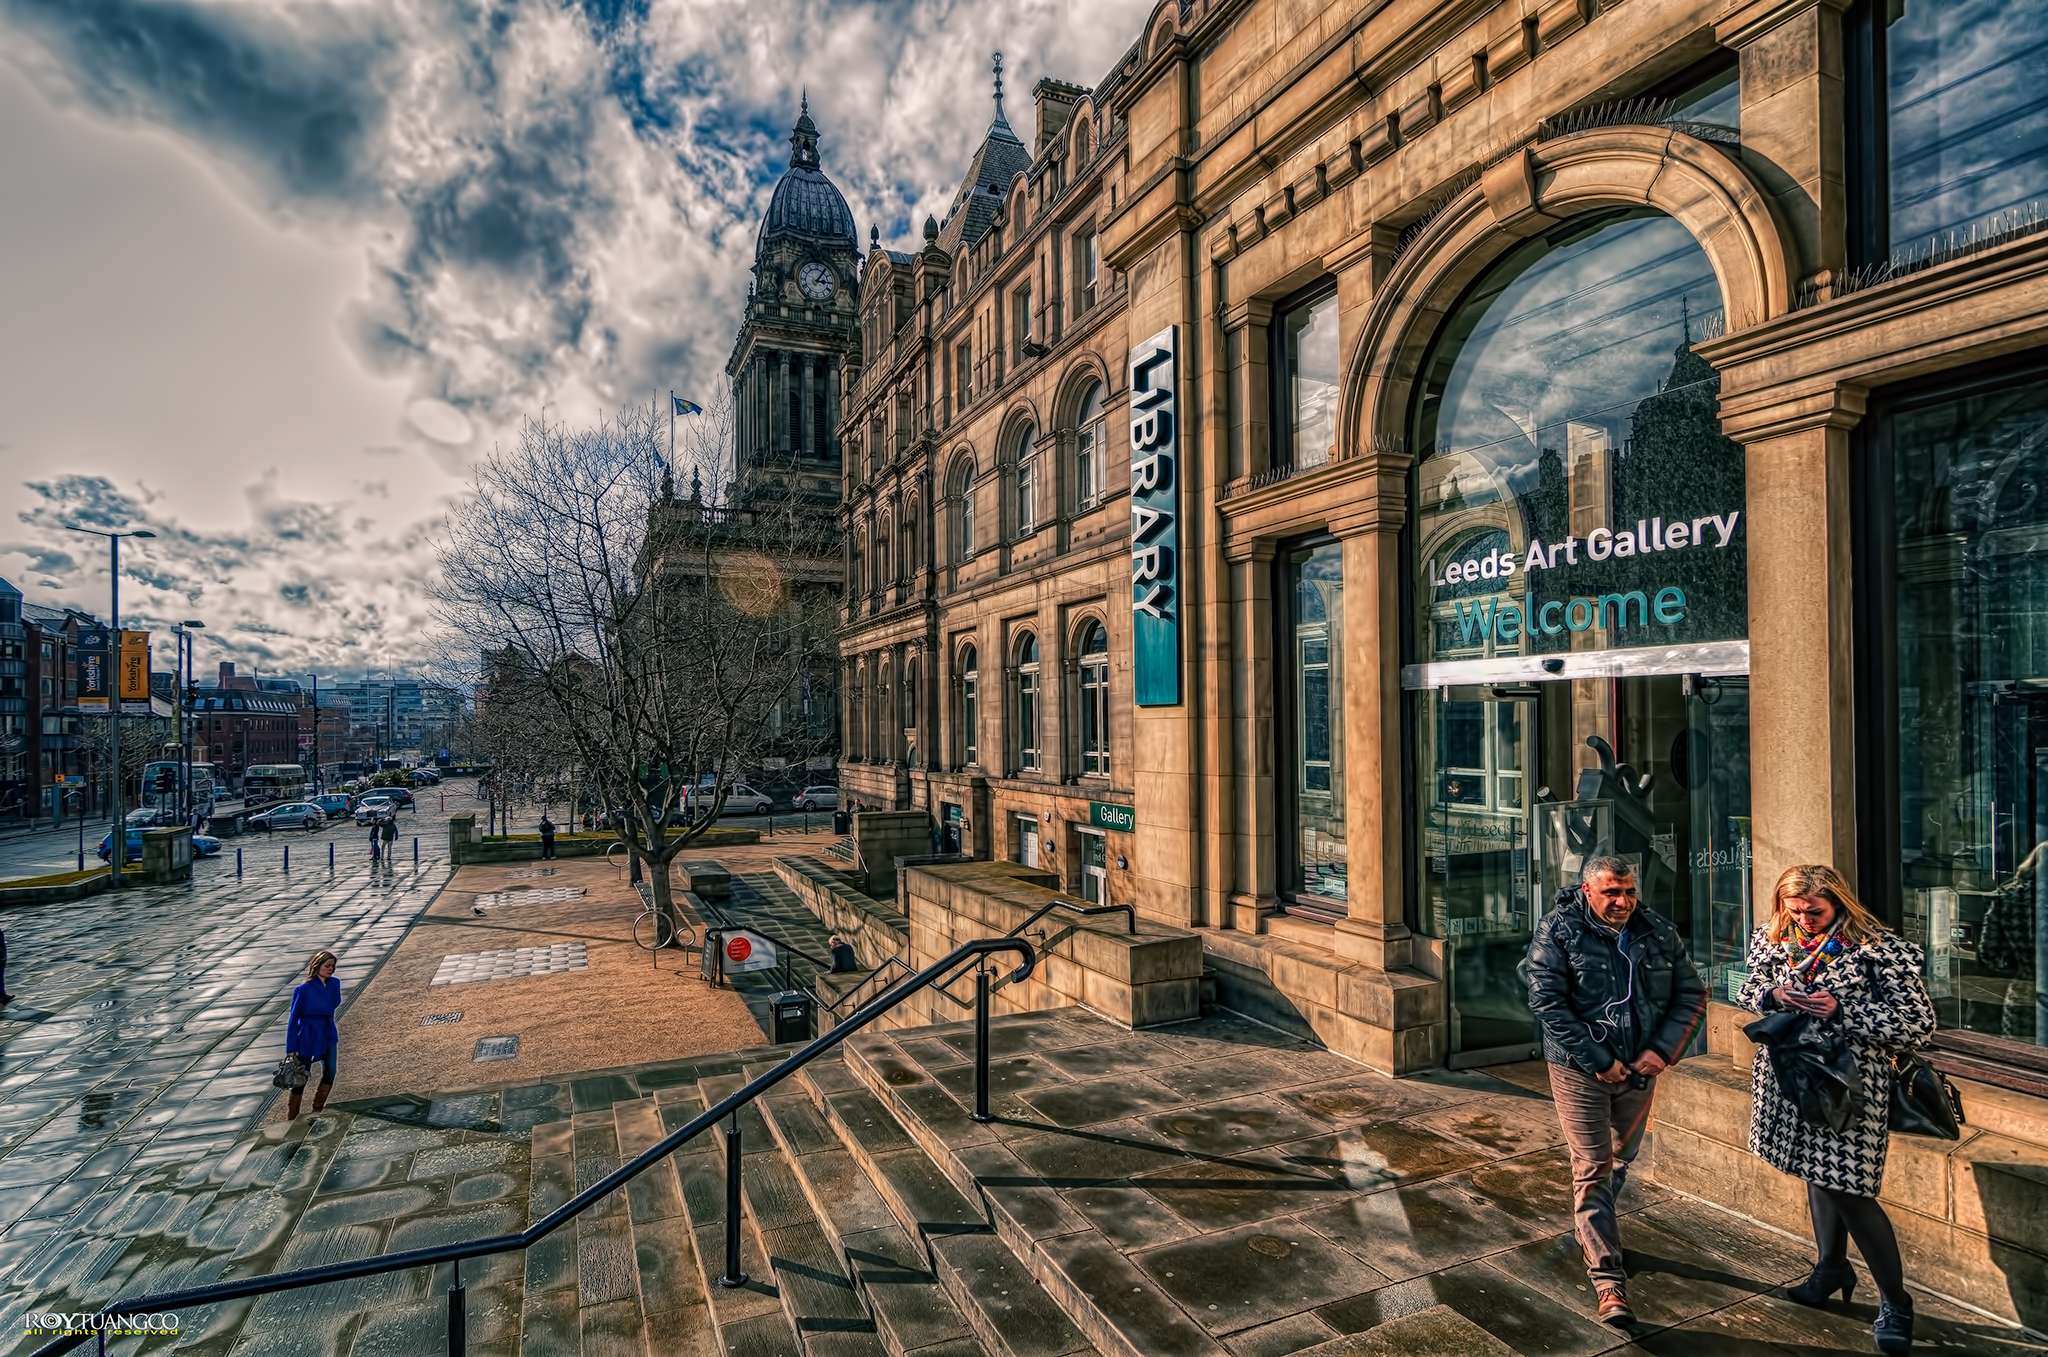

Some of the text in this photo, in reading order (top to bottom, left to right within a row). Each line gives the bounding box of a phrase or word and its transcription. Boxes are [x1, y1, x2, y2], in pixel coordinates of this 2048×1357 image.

[1130, 348, 1168, 620] LIBRARY
[1429, 510, 1740, 588] Leeds Art Gallery
[1455, 584, 1688, 643] Welcome
[1101, 806, 1134, 830] Gallery
